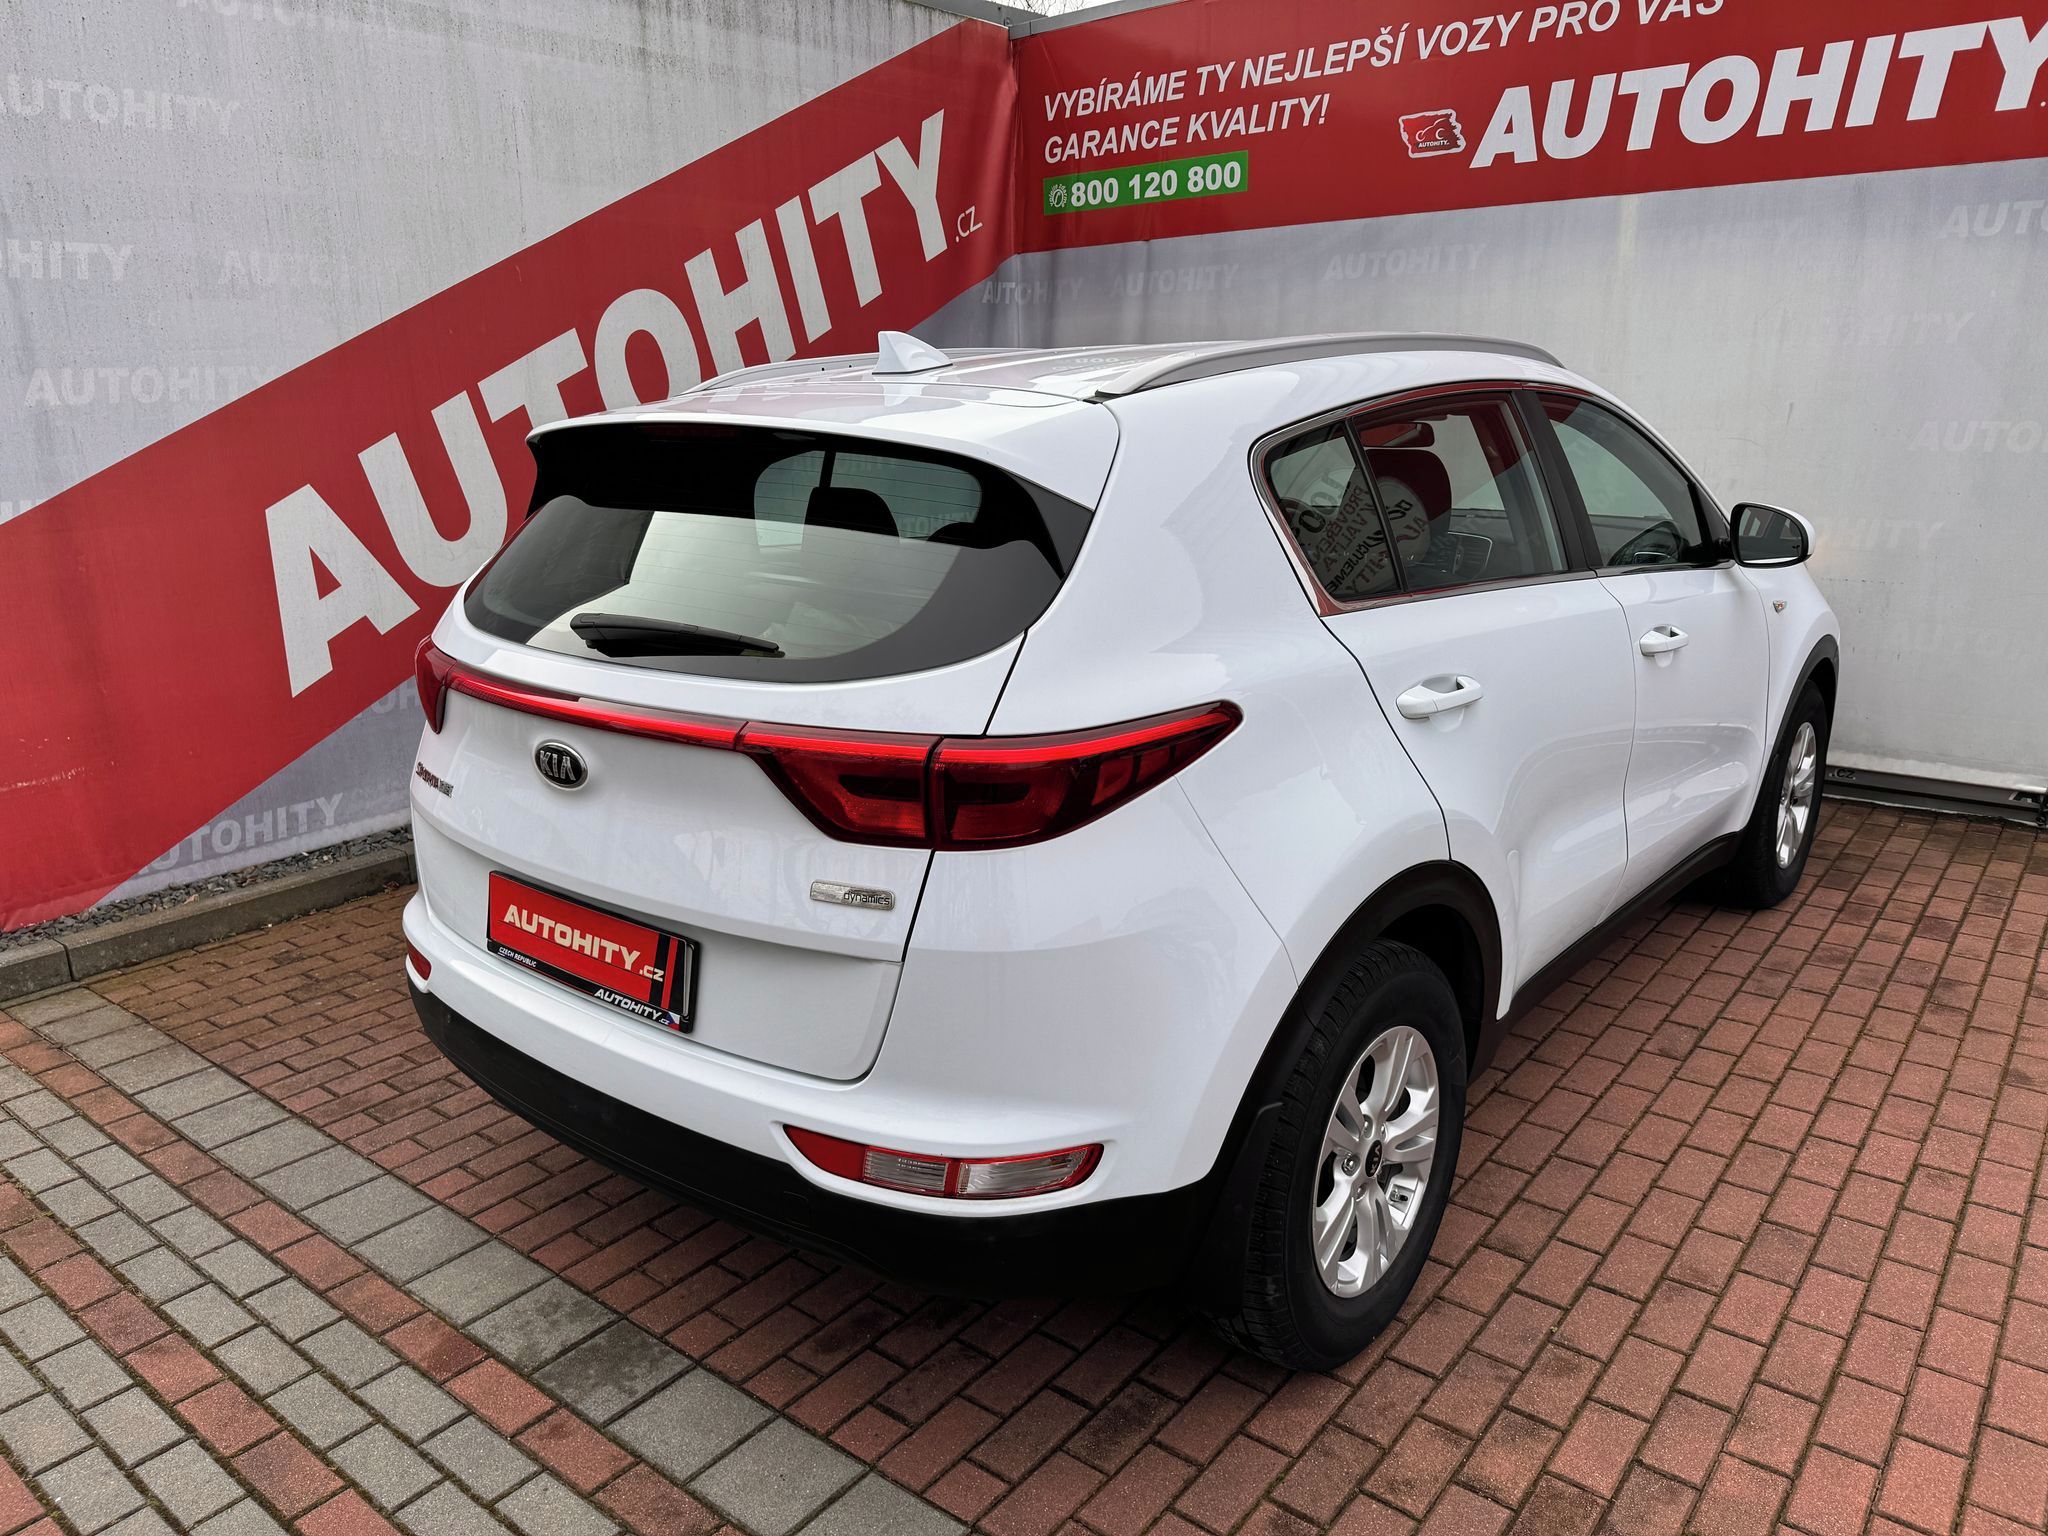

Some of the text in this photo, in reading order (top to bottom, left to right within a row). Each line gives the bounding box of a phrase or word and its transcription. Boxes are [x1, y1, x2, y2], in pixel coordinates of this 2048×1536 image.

[1044, 69, 1185, 121] VYBÍRÁME
[1196, 61, 1237, 96] TY
[1240, 24, 1410, 90] NEJLEPŠÍ
[1417, 11, 1523, 61] VOZY
[1527, 0, 1617, 43] PRO
[0, 74, 240, 137] UTOHITY
[1044, 93, 1330, 164] GARANCE KVALITY!
[1070, 177, 1119, 208] 800
[1128, 170, 1178, 200] 120
[1187, 161, 1242, 193] 800
[540, 750, 576, 780] KIA
[843, 890, 890, 906] dynamics
[499, 946, 537, 968] CZECH REPUBLIC
